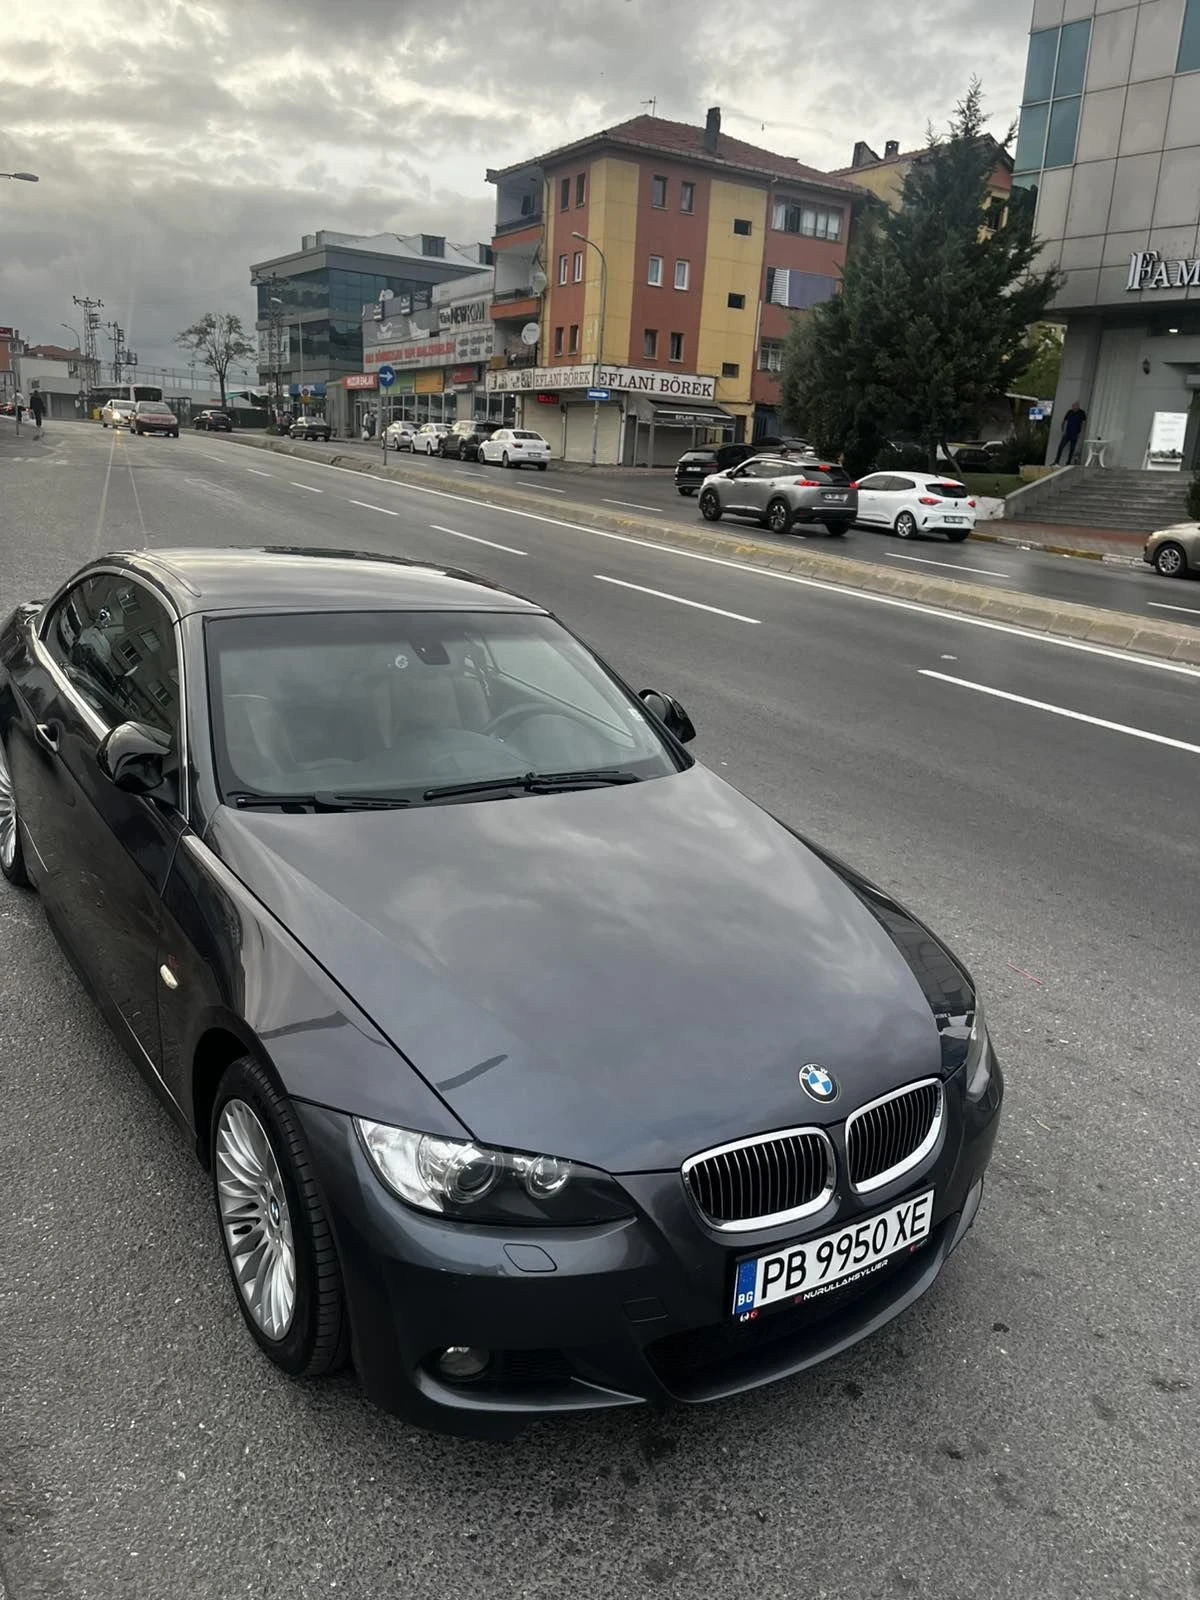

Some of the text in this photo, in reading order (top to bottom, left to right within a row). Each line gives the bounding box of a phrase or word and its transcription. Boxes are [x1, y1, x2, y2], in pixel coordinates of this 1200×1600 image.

[599, 371, 713, 397] EFLANİ BÖREK
[761, 1197, 929, 1300] PB 9950 XE
[737, 1291, 754, 1306] BG
